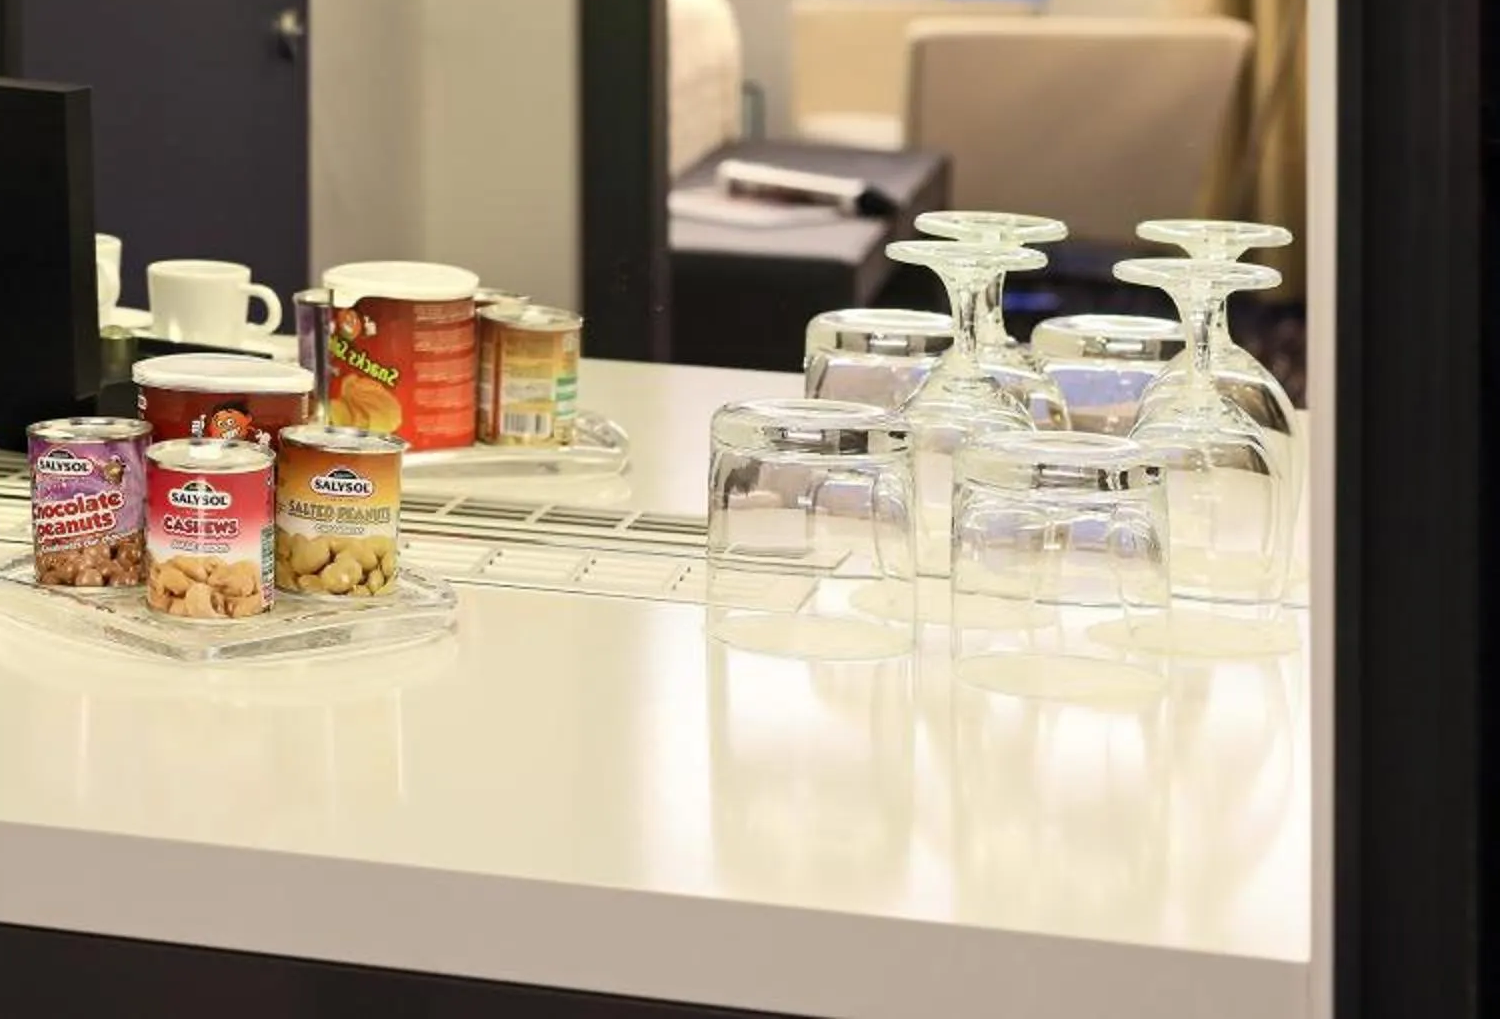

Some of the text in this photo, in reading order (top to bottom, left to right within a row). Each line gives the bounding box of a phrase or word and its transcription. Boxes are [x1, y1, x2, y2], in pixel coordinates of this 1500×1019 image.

[39, 459, 89, 472] SALYSOL
[314, 479, 370, 494] SALYSOL
[171, 492, 228, 506] SALYSOL
[37, 512, 114, 536] peanuts
